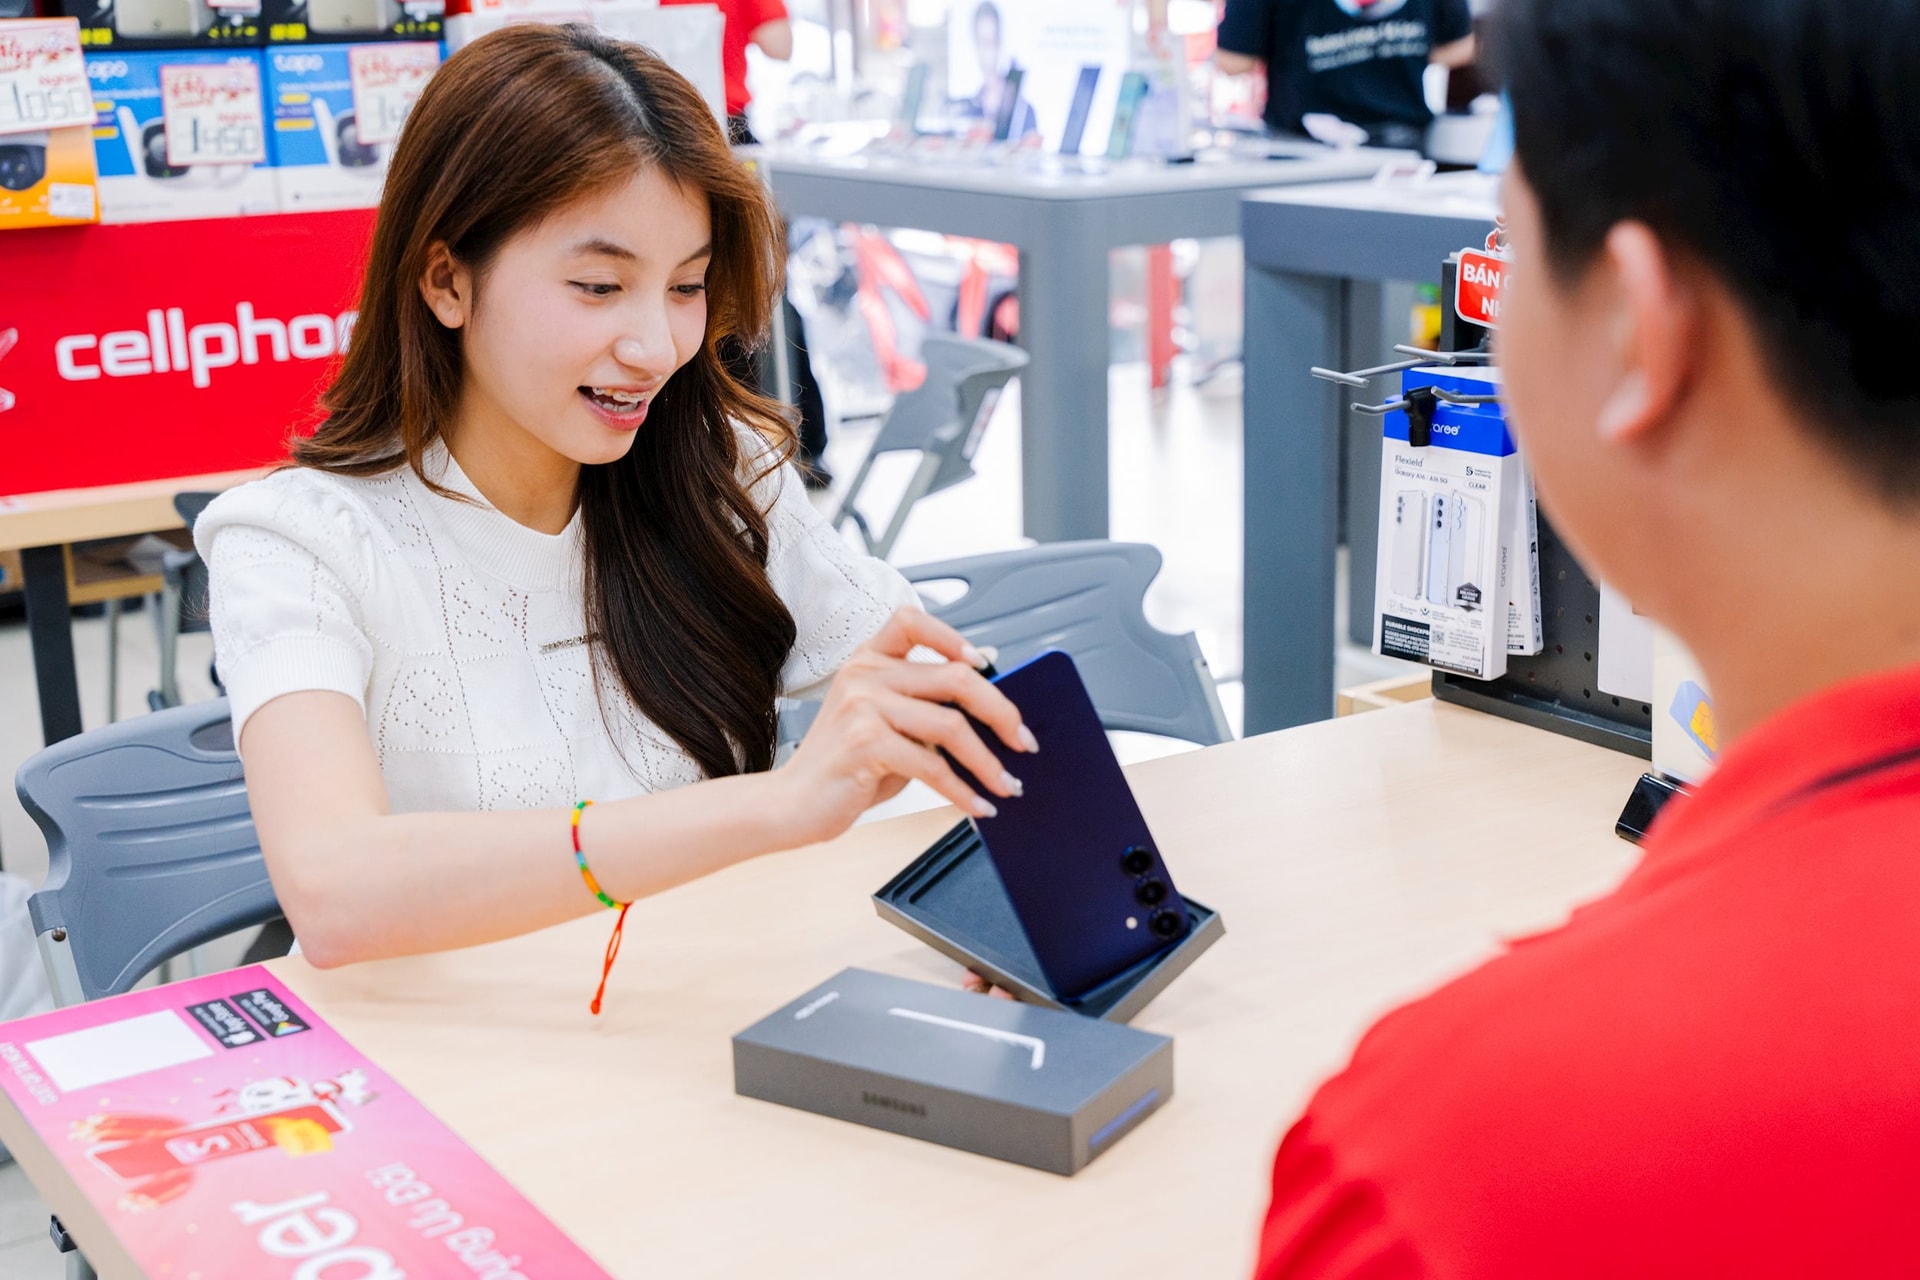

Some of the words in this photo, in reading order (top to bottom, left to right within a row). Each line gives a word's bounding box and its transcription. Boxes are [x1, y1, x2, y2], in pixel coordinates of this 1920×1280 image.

[87, 59, 129, 83] apo
[1463, 263, 1500, 289] BÁN
[1432, 423, 1460, 436] aree
[1468, 482, 1487, 491] CLEAR
